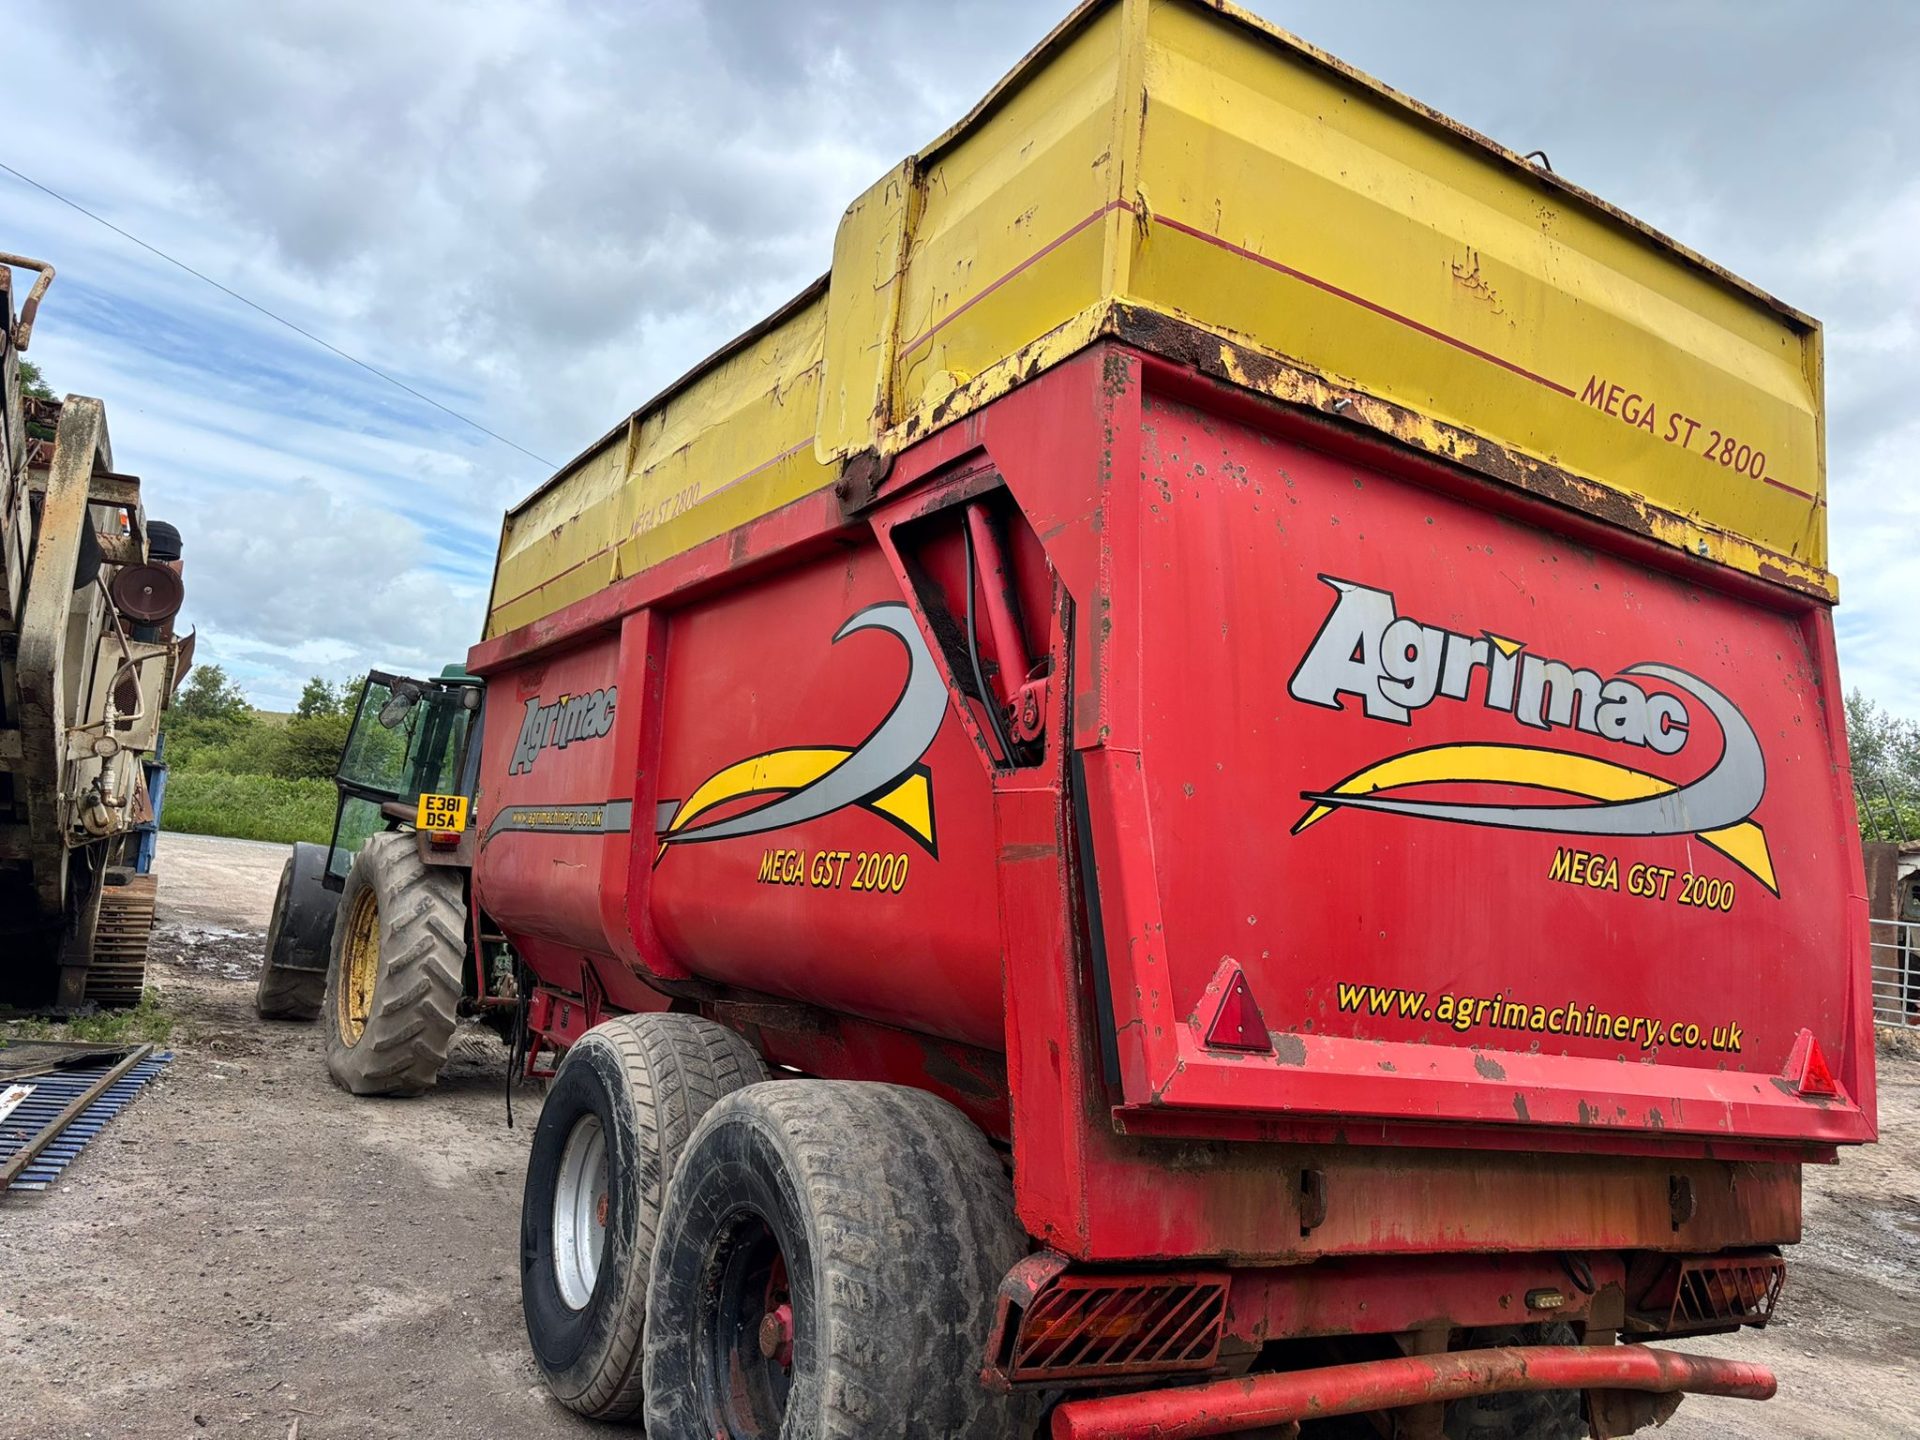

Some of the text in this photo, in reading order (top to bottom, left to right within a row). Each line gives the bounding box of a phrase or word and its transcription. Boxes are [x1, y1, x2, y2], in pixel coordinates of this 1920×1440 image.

[1580, 375, 1766, 479] MEGA ST 2800
[1287, 573, 1690, 754] Agrimac
[508, 686, 617, 776] Agrimac
[426, 796, 461, 812] E381
[426, 812, 455, 828] DSA
[757, 849, 909, 894] MEGA GST 2000
[1548, 846, 1736, 912] MEGA GST 2000
[1337, 982, 1743, 1051] www.agrimachinery.co.uk
